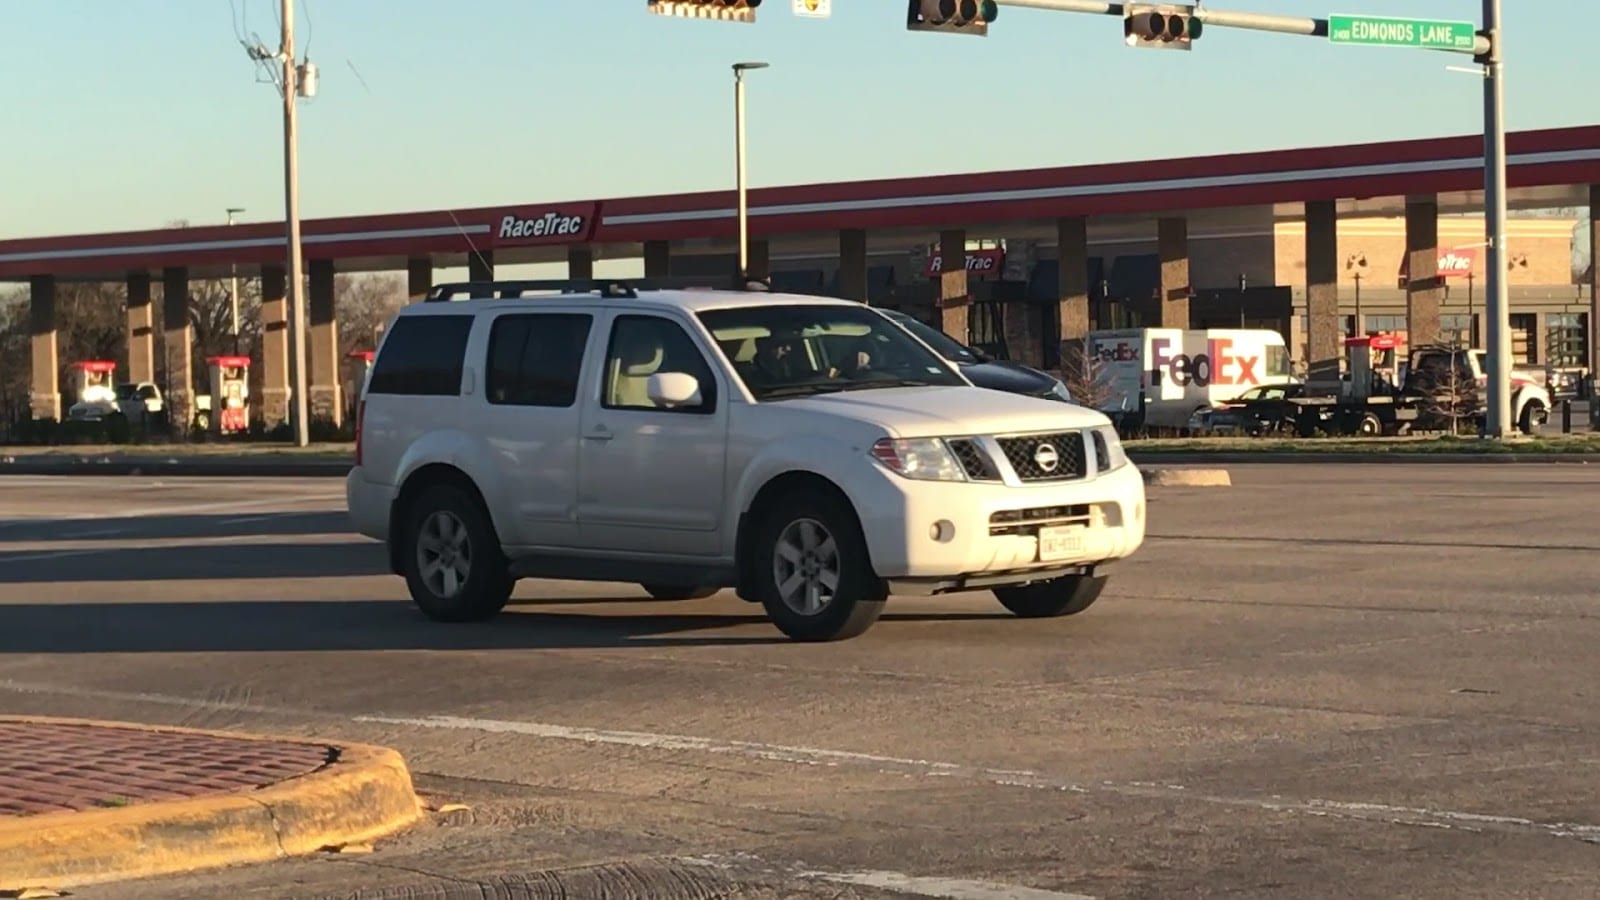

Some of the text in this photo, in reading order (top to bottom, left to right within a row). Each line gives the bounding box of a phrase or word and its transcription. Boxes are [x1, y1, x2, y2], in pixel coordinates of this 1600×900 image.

[1352, 21, 1413, 42] EDMONDS
[1420, 25, 1453, 43] LANE
[499, 213, 581, 238] RaceTrac
[930, 255, 993, 272] RTrac
[1437, 253, 1470, 270] eTrac
[1095, 342, 1140, 362] FedEx
[1151, 338, 1260, 388] FedEx
